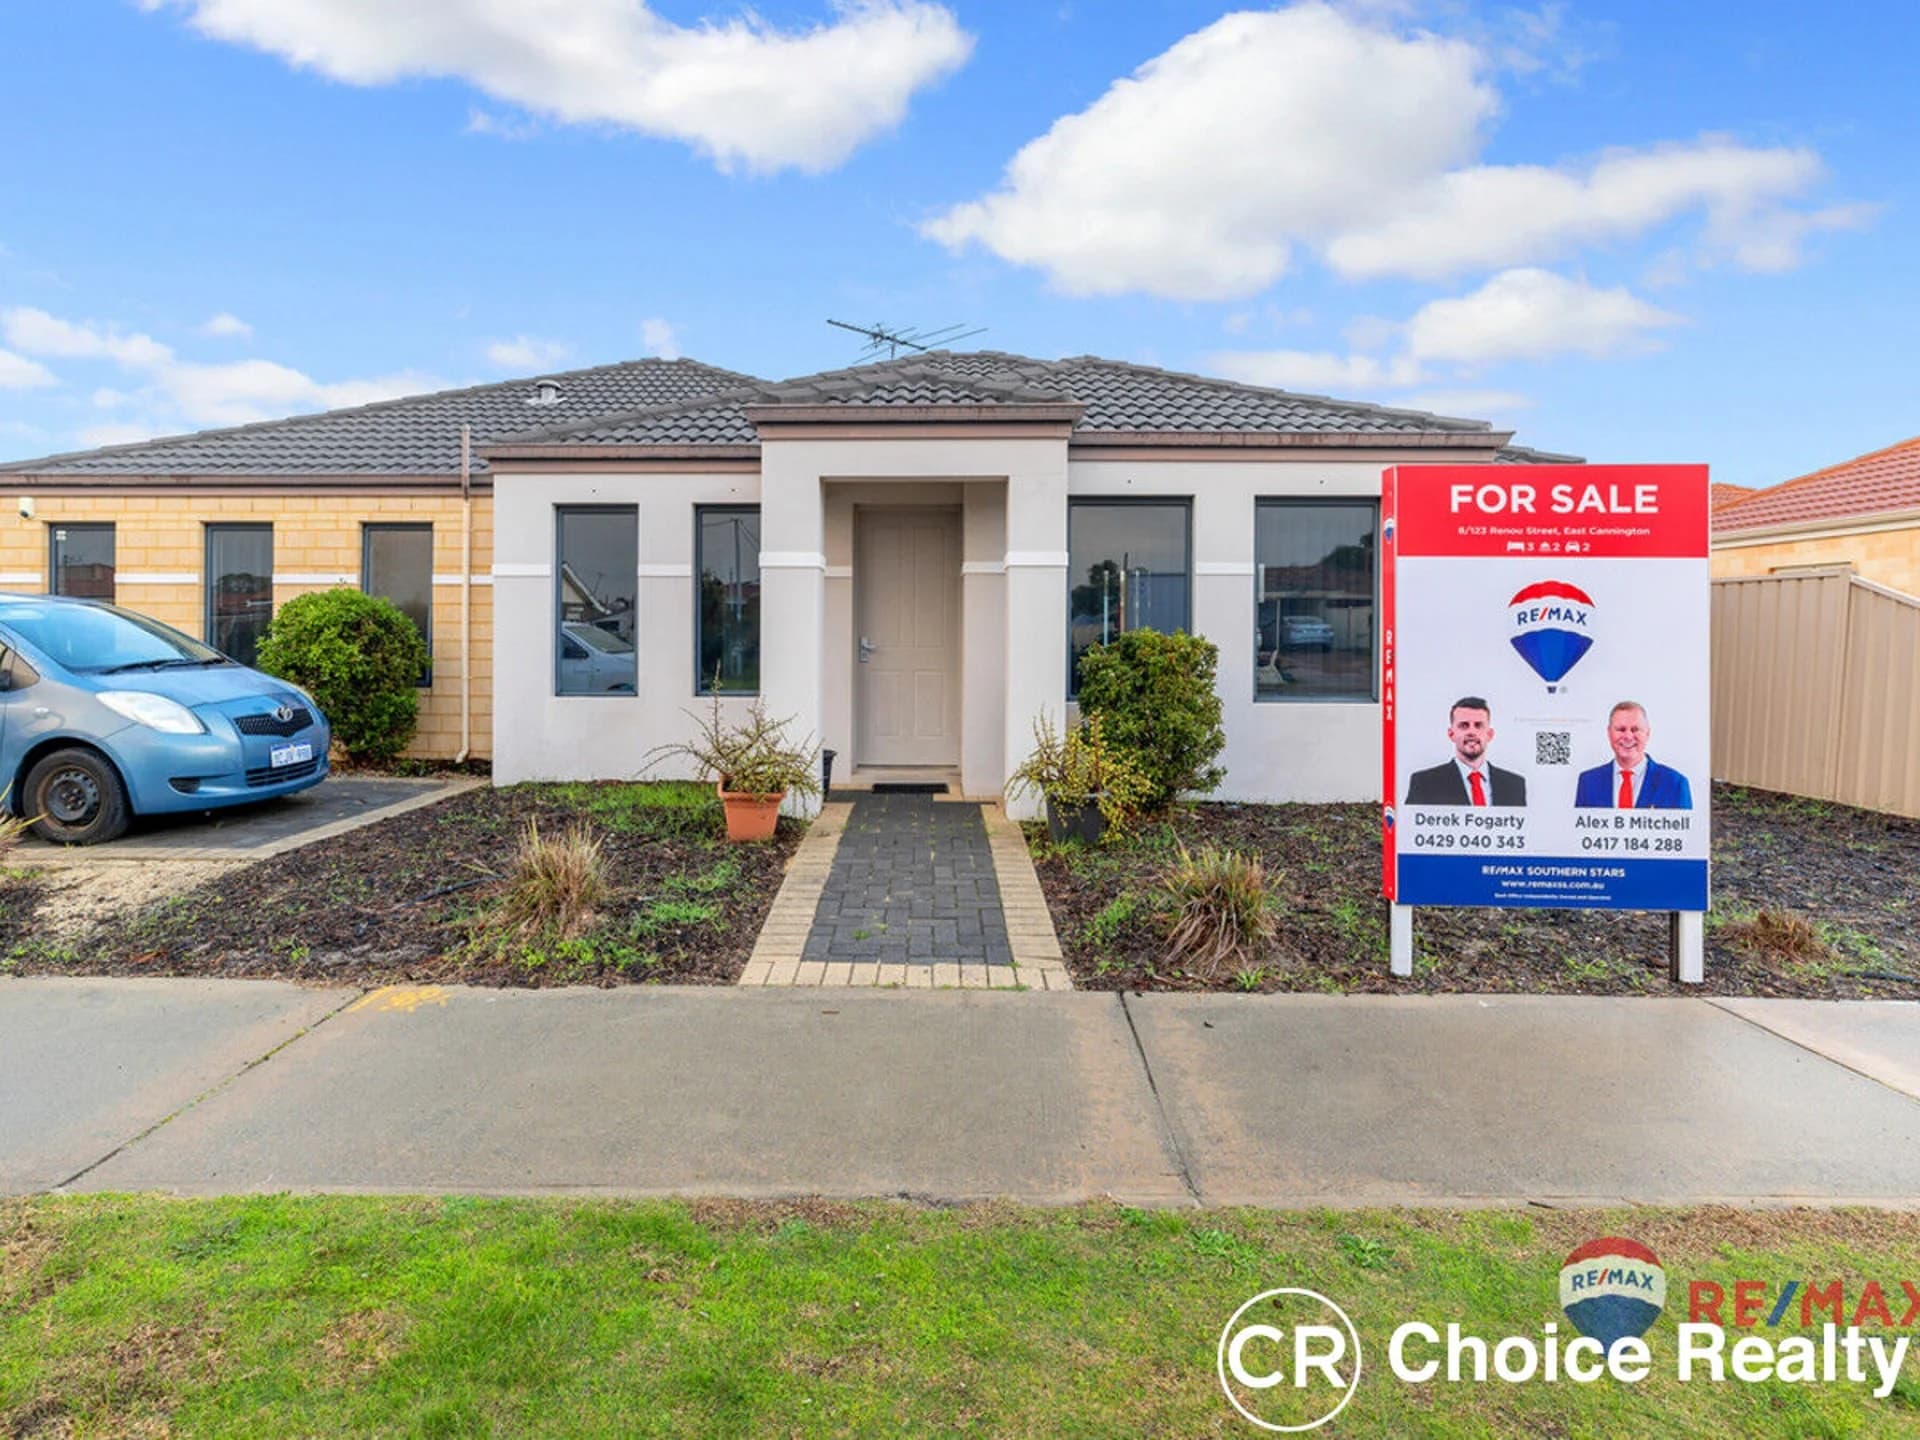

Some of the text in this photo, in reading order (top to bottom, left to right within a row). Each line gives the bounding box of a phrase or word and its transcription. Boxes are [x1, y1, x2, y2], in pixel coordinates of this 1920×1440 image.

[1451, 484, 1659, 514] FOR SALE
[1526, 526, 1561, 536] Street,
[1563, 527, 1586, 535] East
[1589, 527, 1650, 537] Cannington
[1527, 542, 1590, 552] 3 2 2
[1517, 607, 1587, 626] RE/MAX
[1415, 812, 1525, 830] Derek Fogarty
[1575, 815, 1690, 830] Alex B Mitchell
[1415, 834, 1525, 849] 0429 040 343
[1582, 836, 1683, 852] 0417 184 288
[1481, 865, 1626, 878] RE/MAX SOUTHERN STARS
